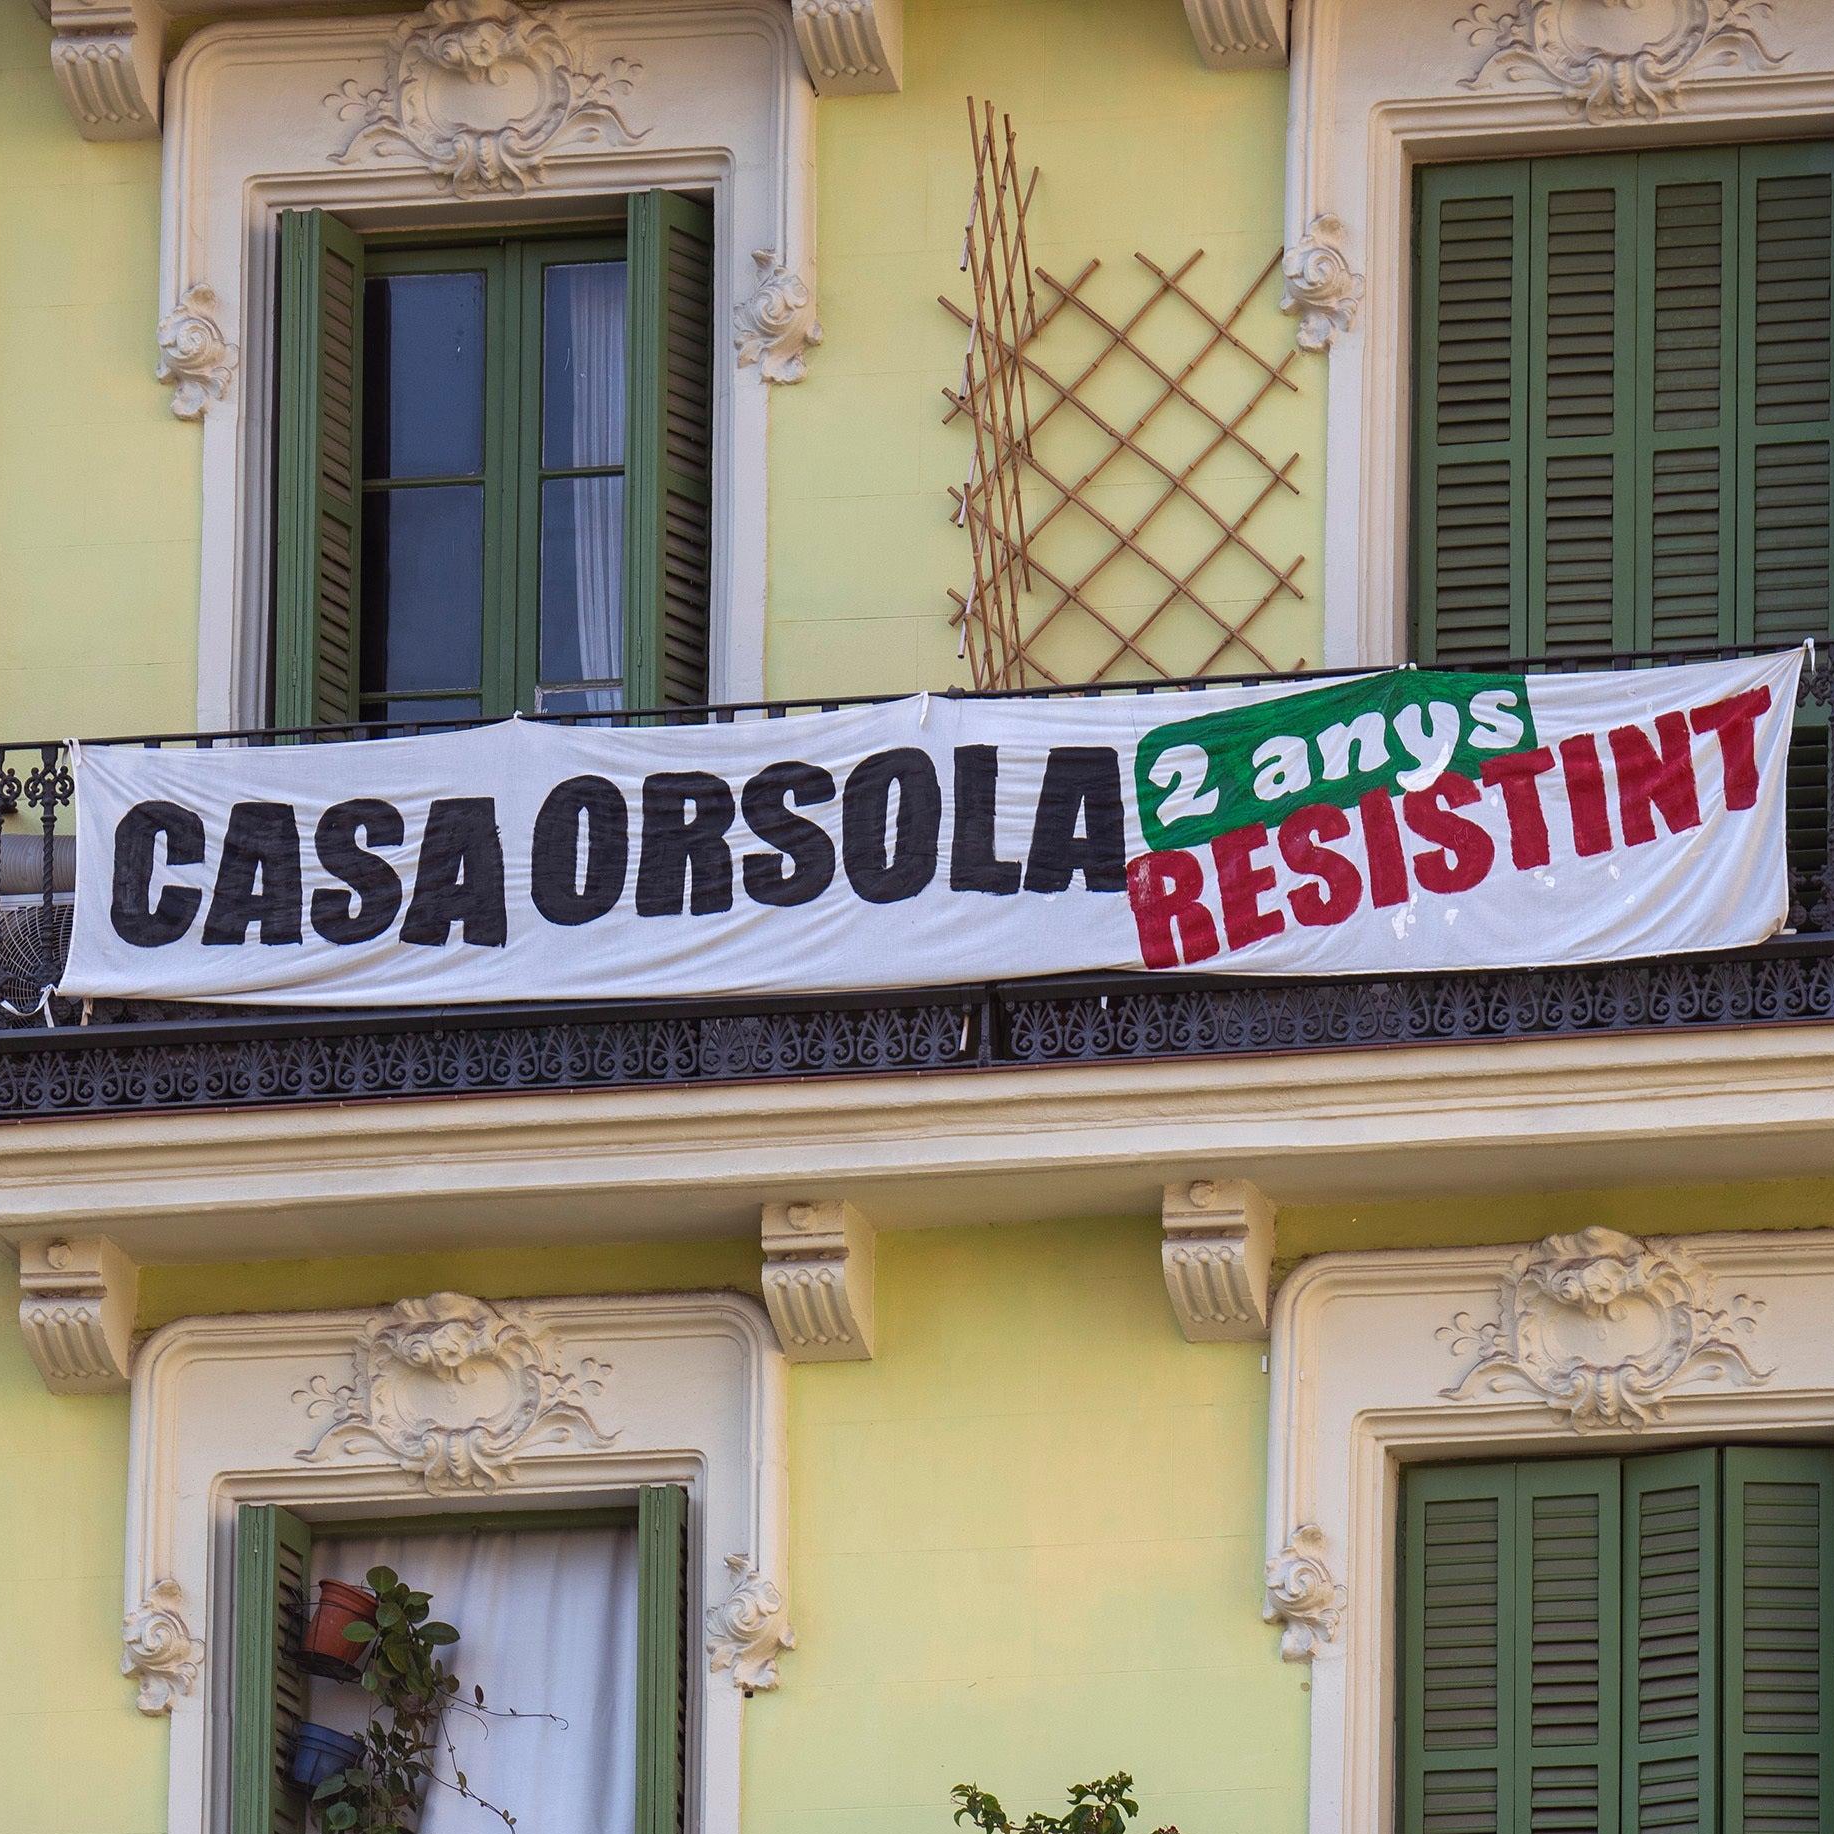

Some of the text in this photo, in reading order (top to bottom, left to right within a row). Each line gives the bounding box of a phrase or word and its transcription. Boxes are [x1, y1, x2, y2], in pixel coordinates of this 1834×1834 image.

[109, 743, 1126, 948] CASA ORSOLA
[1126, 686, 1771, 970] RESISTINT
[1147, 689, 1525, 827] 2 anys
